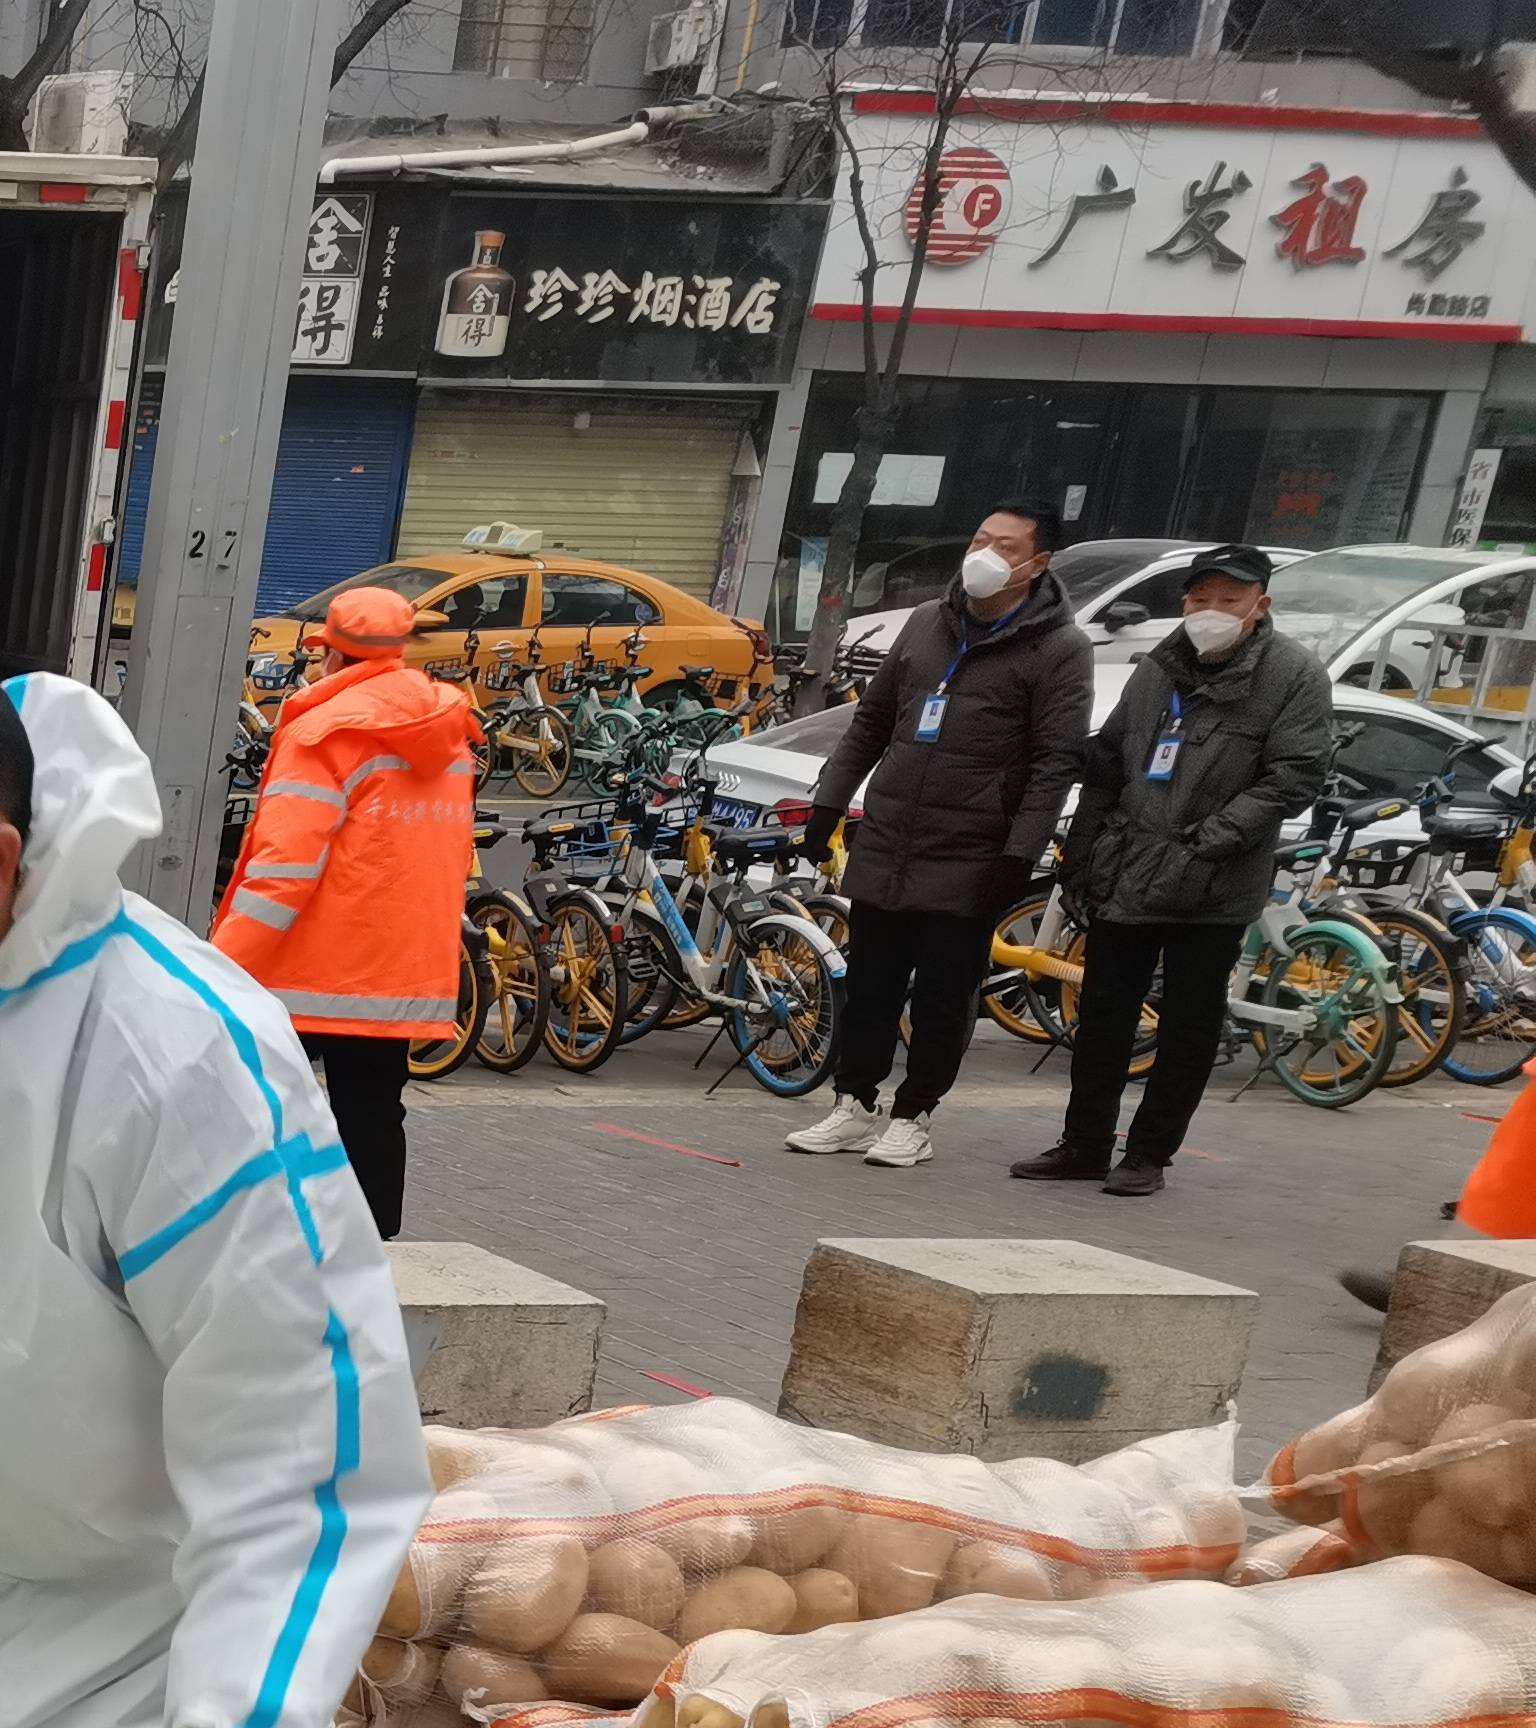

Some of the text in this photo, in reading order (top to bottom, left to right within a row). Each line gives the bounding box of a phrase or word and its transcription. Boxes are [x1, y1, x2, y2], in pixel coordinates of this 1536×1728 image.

[1027, 160, 1487, 283] 广发租房
[291, 196, 364, 357] 舍得
[461, 282, 495, 347] 舍得
[524, 265, 782, 335] 珍珍烟酒店
[1448, 460, 1493, 546] 省市医保
